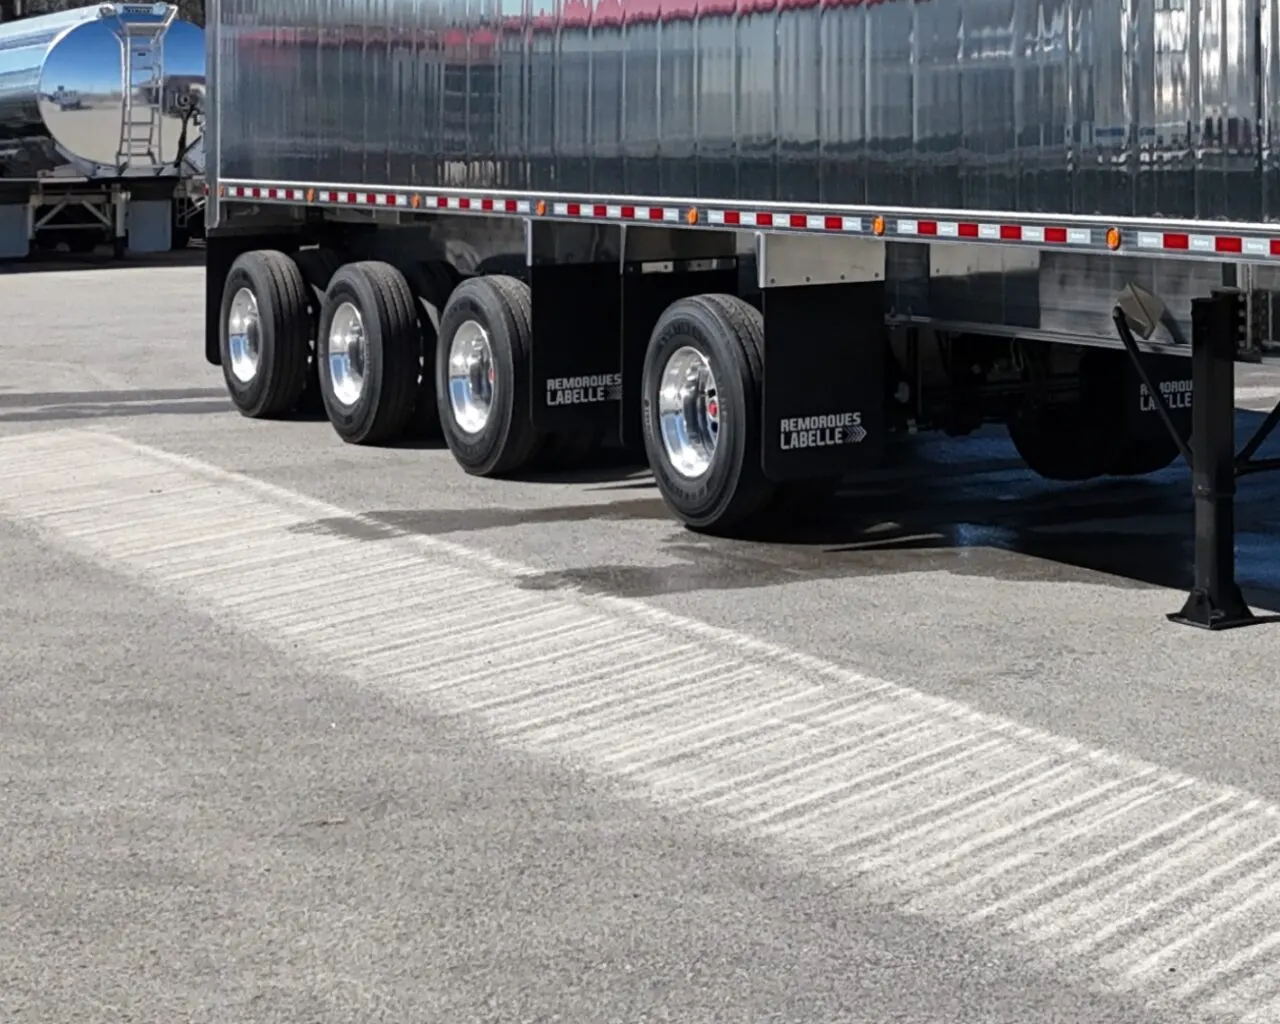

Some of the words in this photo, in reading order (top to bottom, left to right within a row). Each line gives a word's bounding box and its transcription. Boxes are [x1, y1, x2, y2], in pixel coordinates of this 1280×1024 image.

[546, 373, 622, 391] REMORQUES
[546, 387, 605, 406] LABELLE
[1139, 392, 1192, 411] LALLE
[780, 412, 861, 432] REMORQUES
[780, 427, 843, 450] LABELLE
